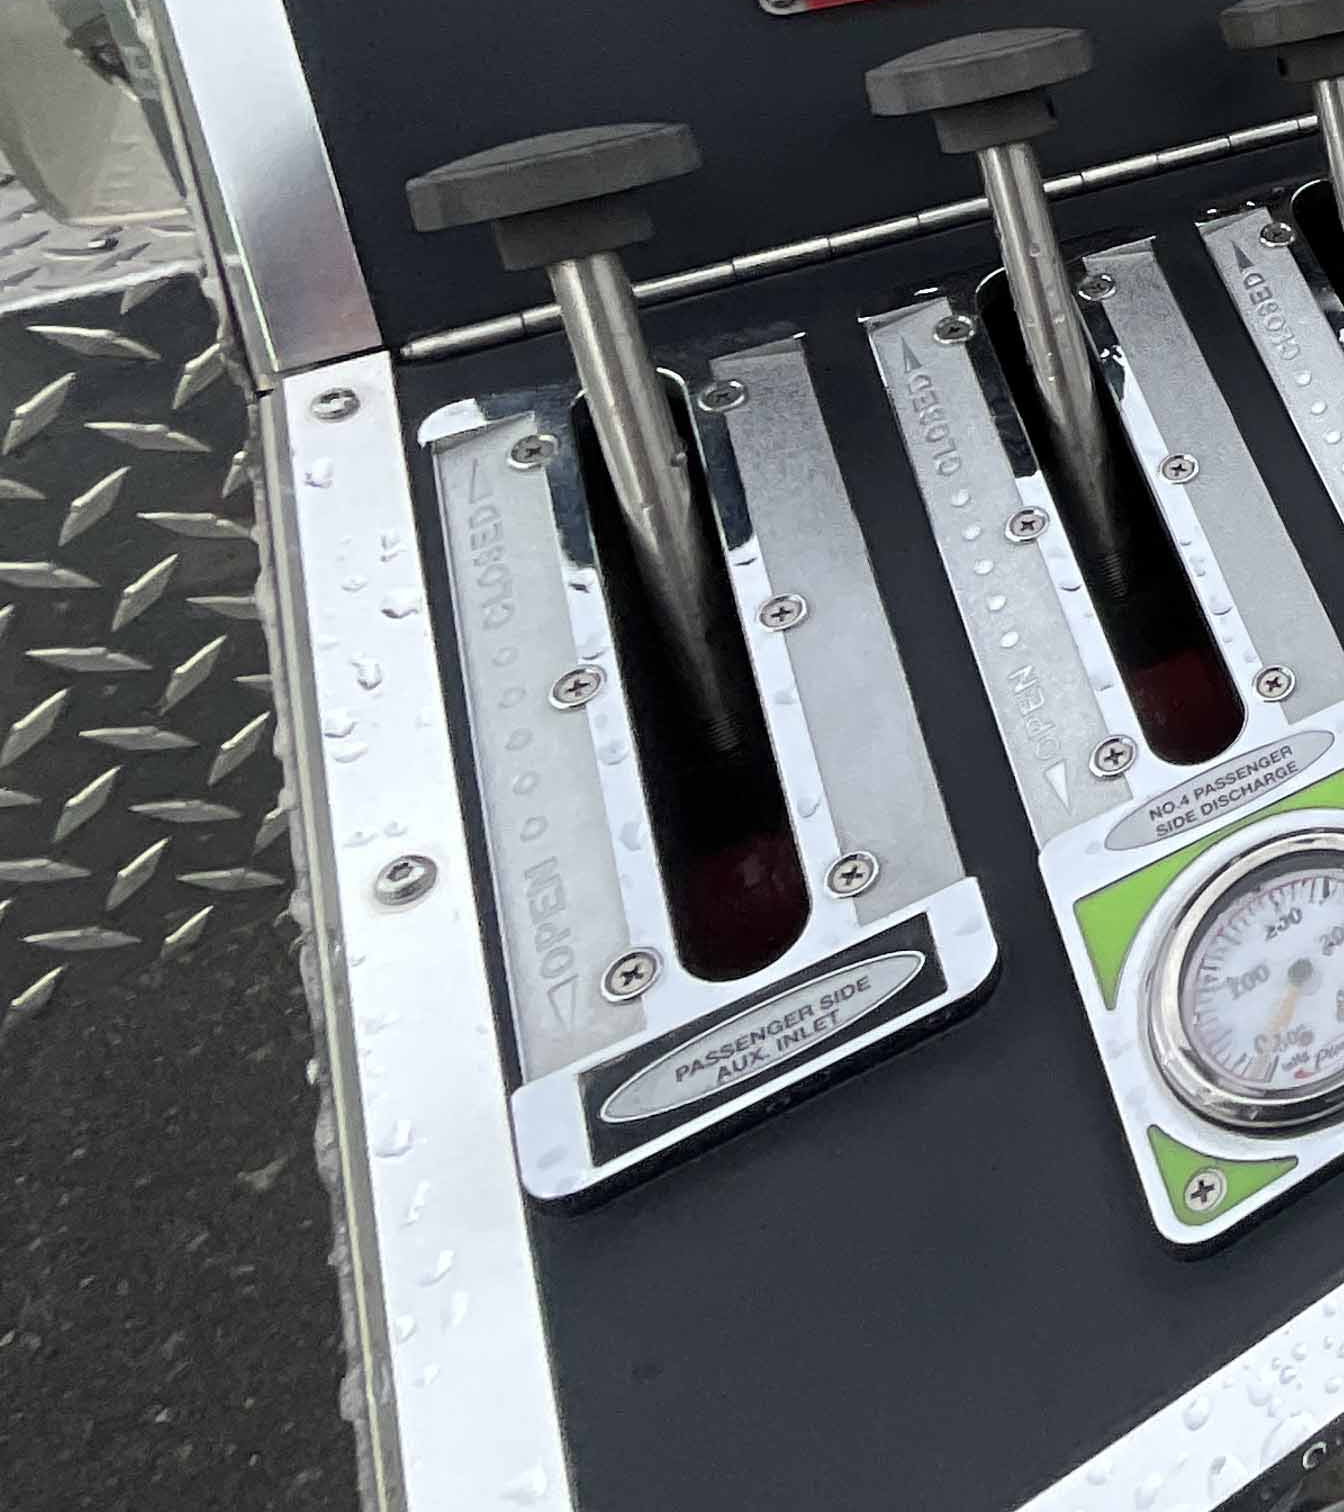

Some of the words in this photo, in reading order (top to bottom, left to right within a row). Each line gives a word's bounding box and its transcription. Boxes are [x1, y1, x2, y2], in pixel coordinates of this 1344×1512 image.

[1242, 272, 1302, 362] CLOSED
[904, 372, 962, 478] CLOSED
[468, 505, 515, 631] CLOSED
[1155, 810, 1198, 838] SIDE
[1199, 759, 1300, 817] DISCHARGE
[1193, 744, 1295, 801] PASSENGER
[522, 855, 576, 980] OPEN
[673, 1003, 816, 1083] PASSENGER
[818, 974, 872, 1011] SIDE
[714, 1045, 771, 1086] AUX.
[775, 1008, 841, 1052] INLET
